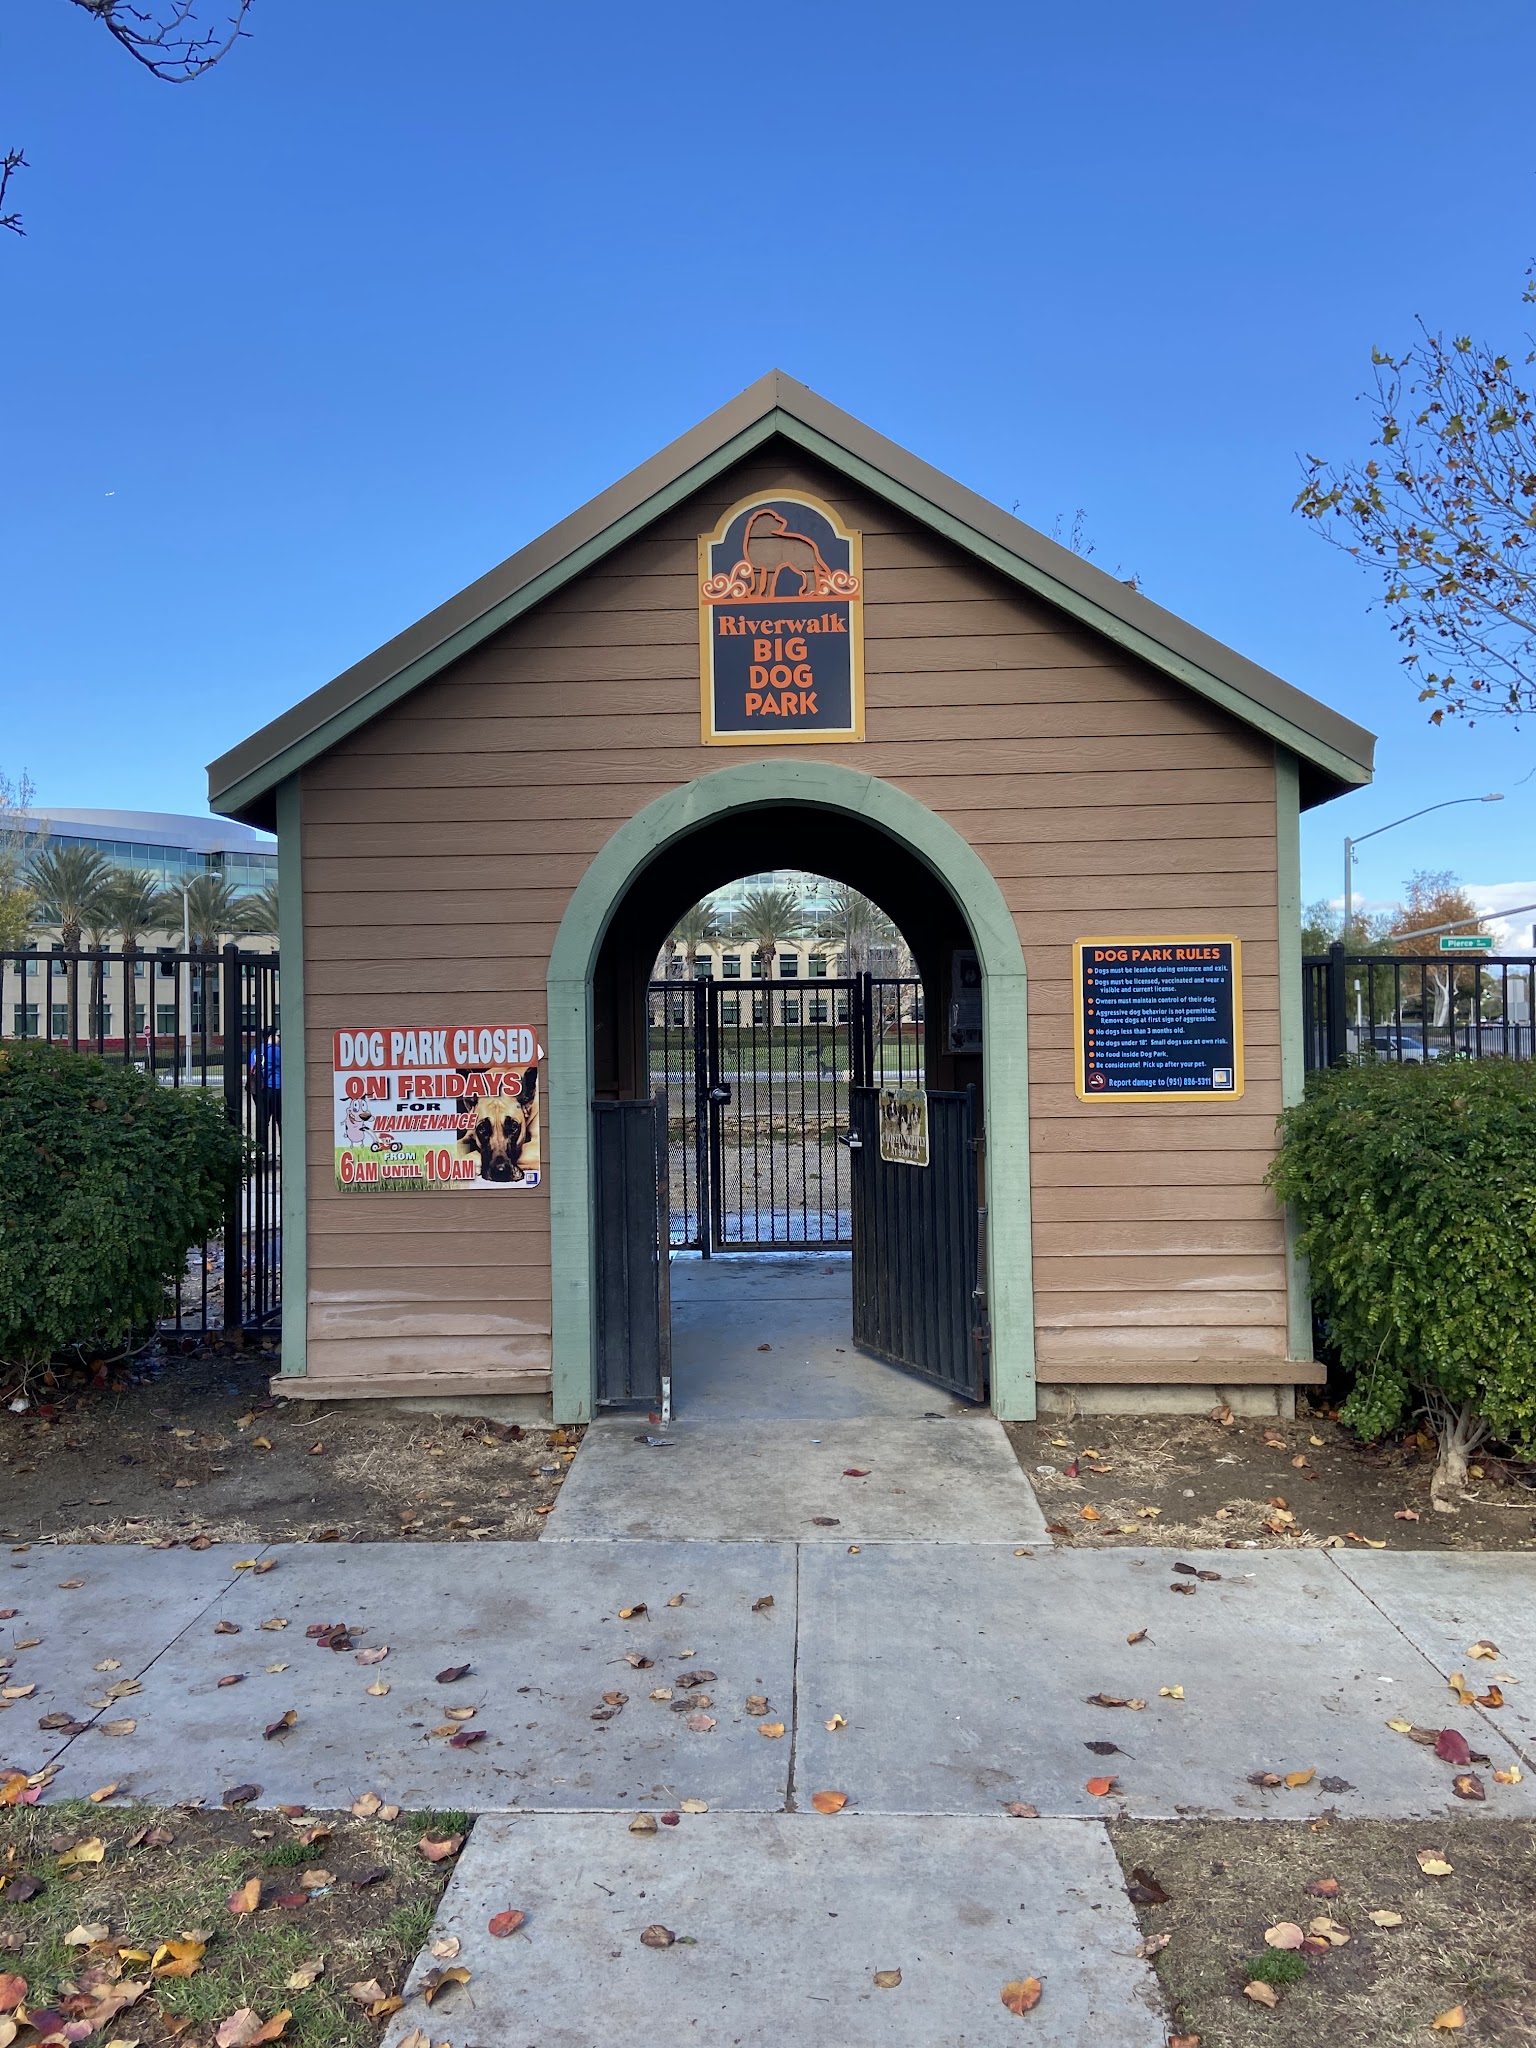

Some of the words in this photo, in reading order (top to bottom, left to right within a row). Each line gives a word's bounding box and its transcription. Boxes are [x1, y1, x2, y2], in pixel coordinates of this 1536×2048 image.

[718, 613, 847, 636] Riverwalk
[754, 638, 807, 661] BIG
[750, 664, 812, 689] DOG
[746, 691, 818, 716] PARK
[1095, 950, 1128, 961] DOG
[1132, 949, 1172, 961] PARK
[1176, 948, 1220, 960] RULES
[340, 1032, 383, 1067] DOG
[391, 1030, 448, 1066] PARK
[454, 1028, 533, 1065] CLOSED
[345, 1076, 387, 1099] ON
[398, 1073, 522, 1098] FRIDAYS
[1109, 1079, 1131, 1087] Report
[1132, 1078, 1156, 1087] damage
[1167, 1077, 1182, 1087] (951)
[397, 1103, 440, 1111] FOR
[373, 1113, 477, 1131] MAINTENANCE
[382, 1165, 422, 1177] UNTIL
